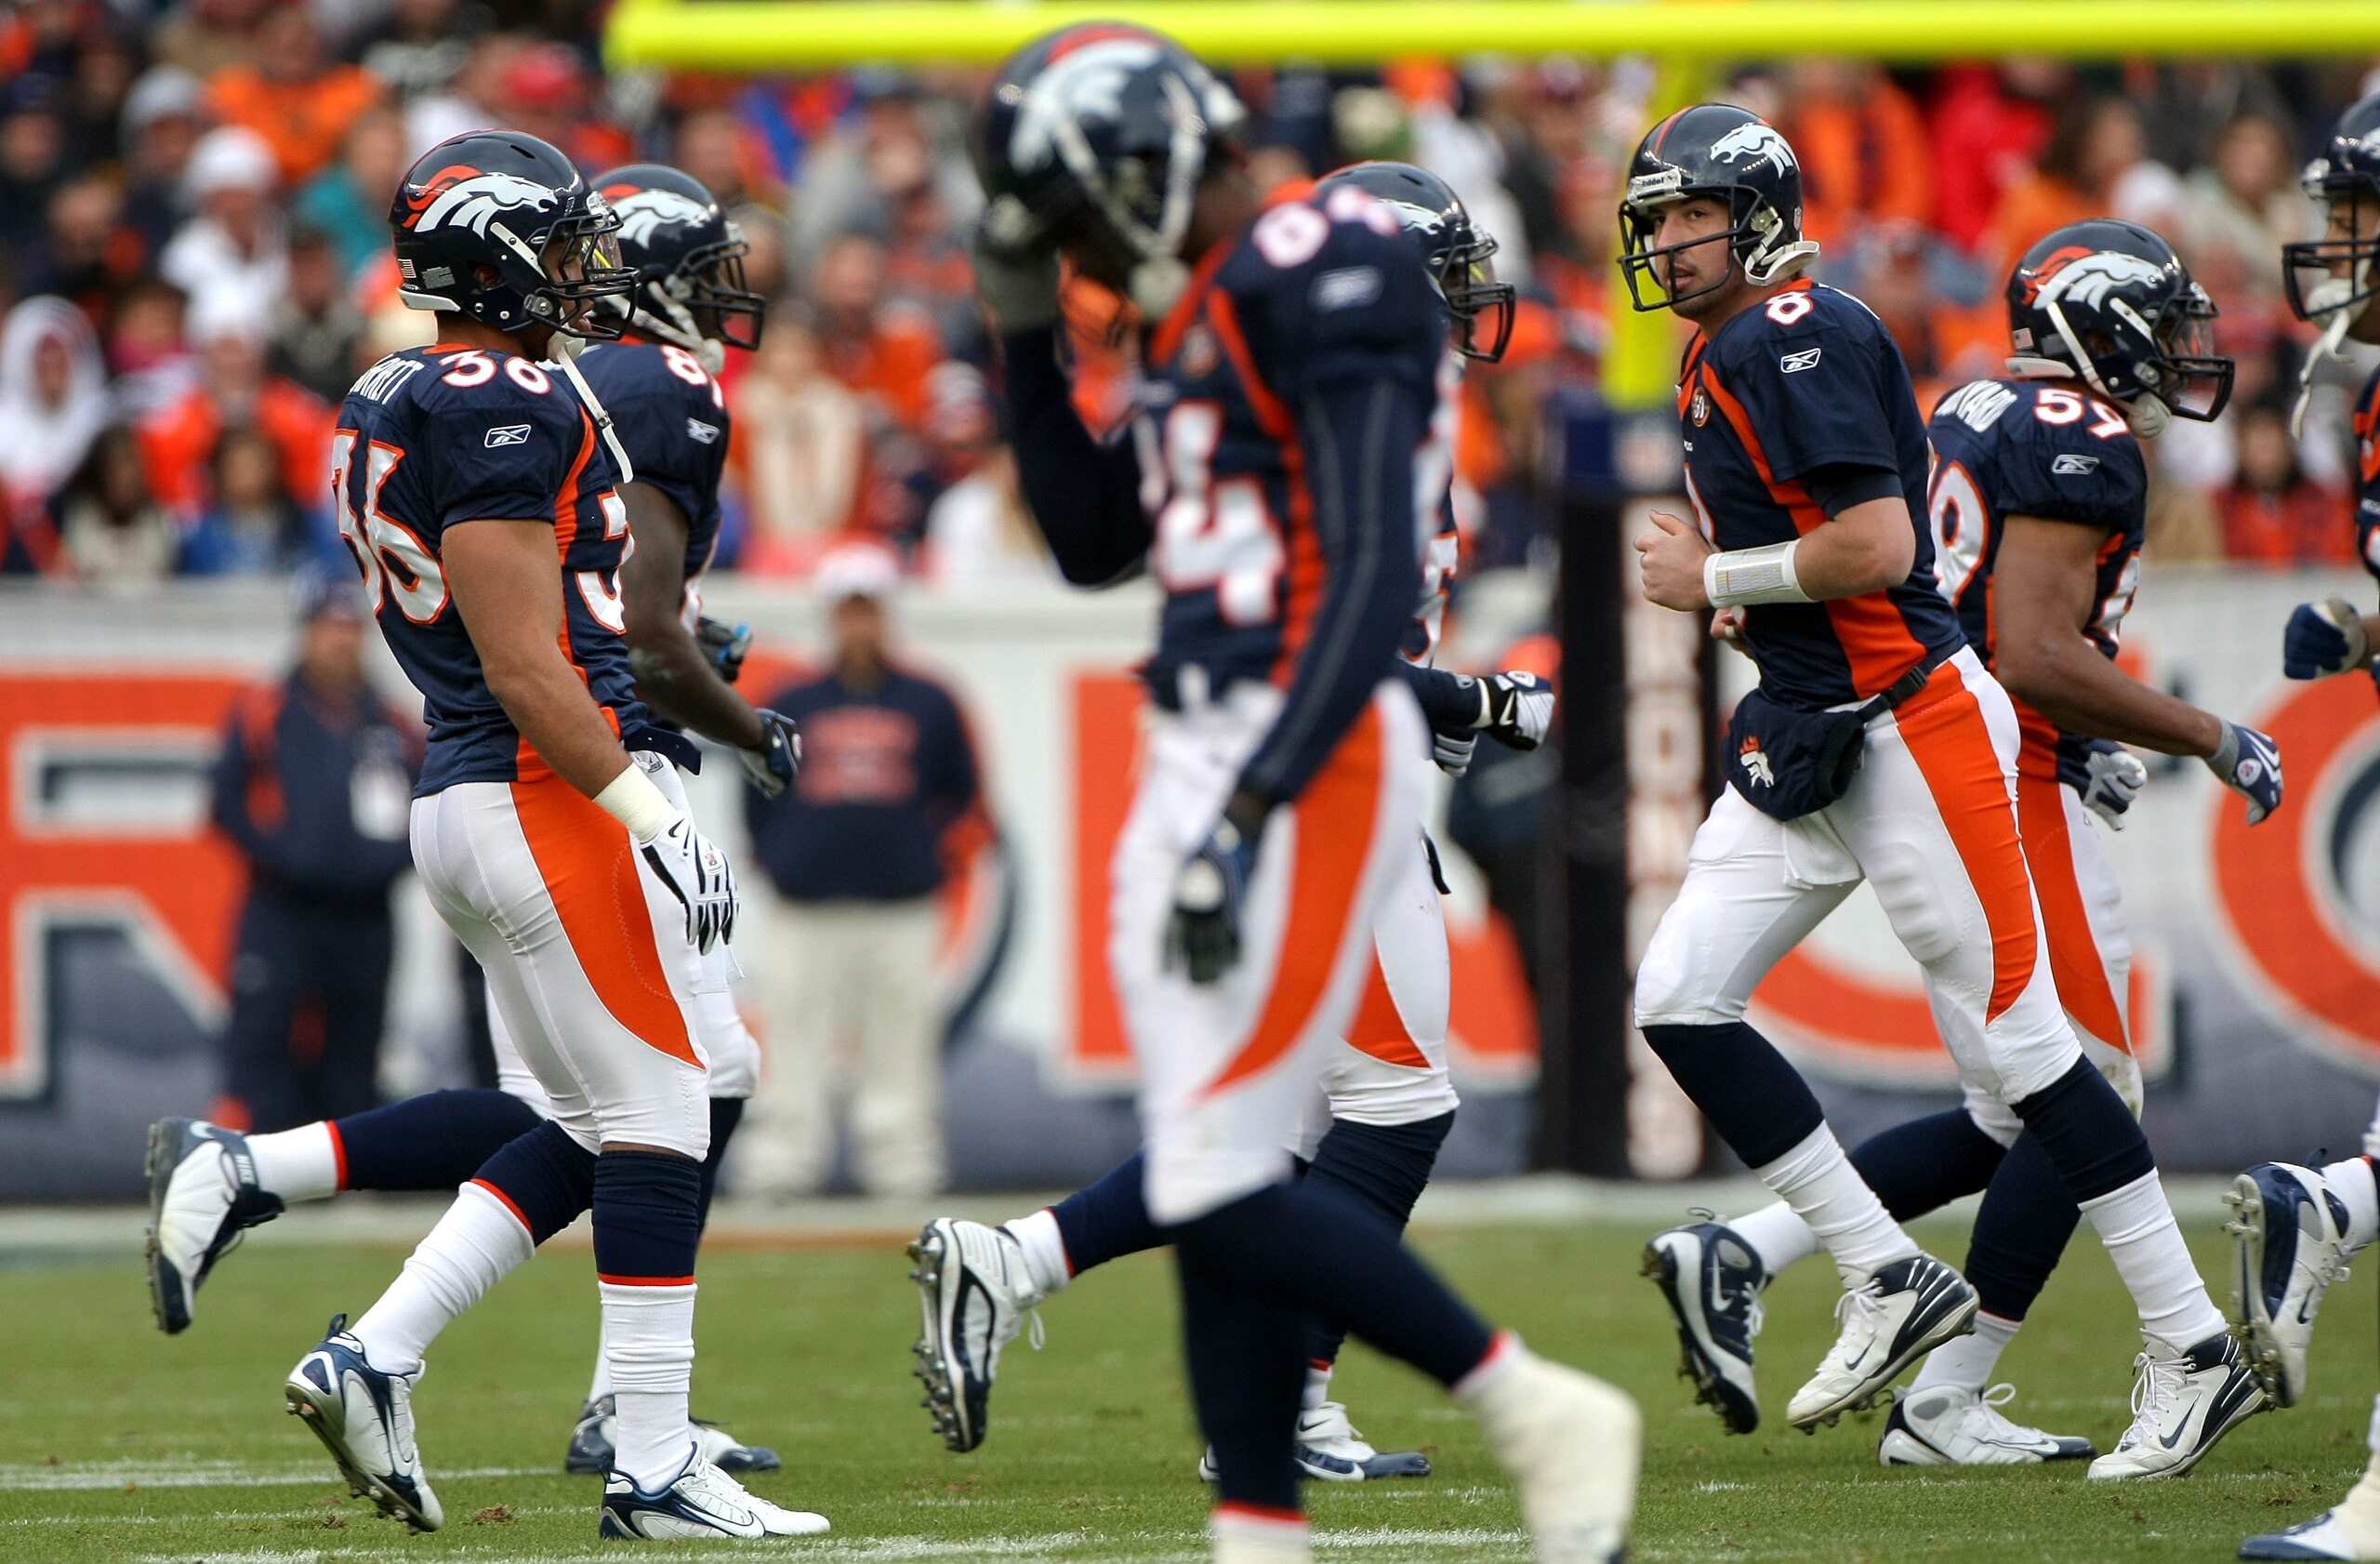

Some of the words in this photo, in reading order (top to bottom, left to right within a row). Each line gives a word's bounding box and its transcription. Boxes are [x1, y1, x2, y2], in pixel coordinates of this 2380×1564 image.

[1765, 290, 1814, 325] 8
[438, 350, 552, 396] 36
[660, 345, 724, 410] 8
[2032, 387, 2131, 440] 59
[1130, 398, 1287, 629] 4
